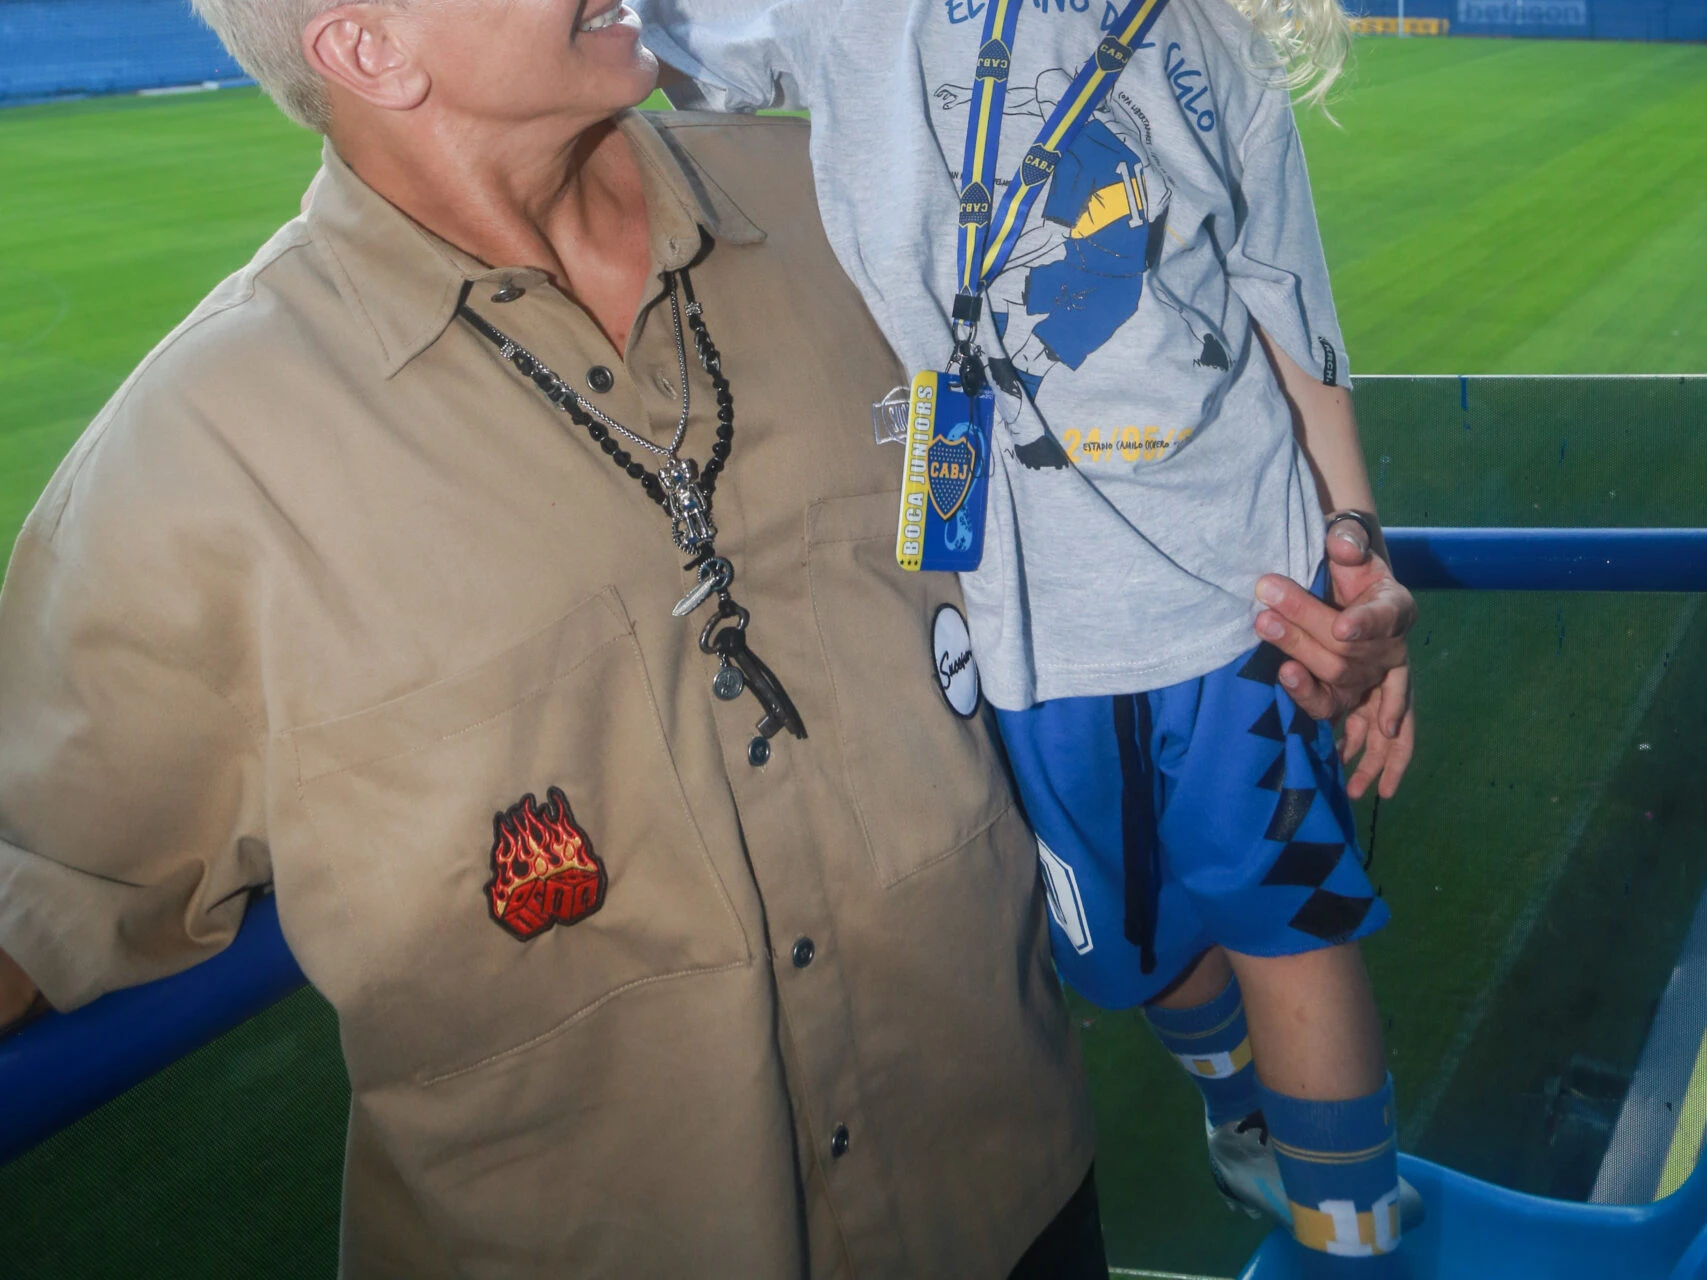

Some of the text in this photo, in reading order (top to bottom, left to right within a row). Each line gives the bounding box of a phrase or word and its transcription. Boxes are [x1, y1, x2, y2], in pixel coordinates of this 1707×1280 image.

[1100, 43, 1130, 64] CABJ
[977, 58, 1008, 69] CABJ
[1024, 154, 1055, 172] CABJ
[960, 202, 988, 212] CABJ
[903, 385, 934, 556] BOCA JUNIORS
[930, 461, 968, 480] CABJ
